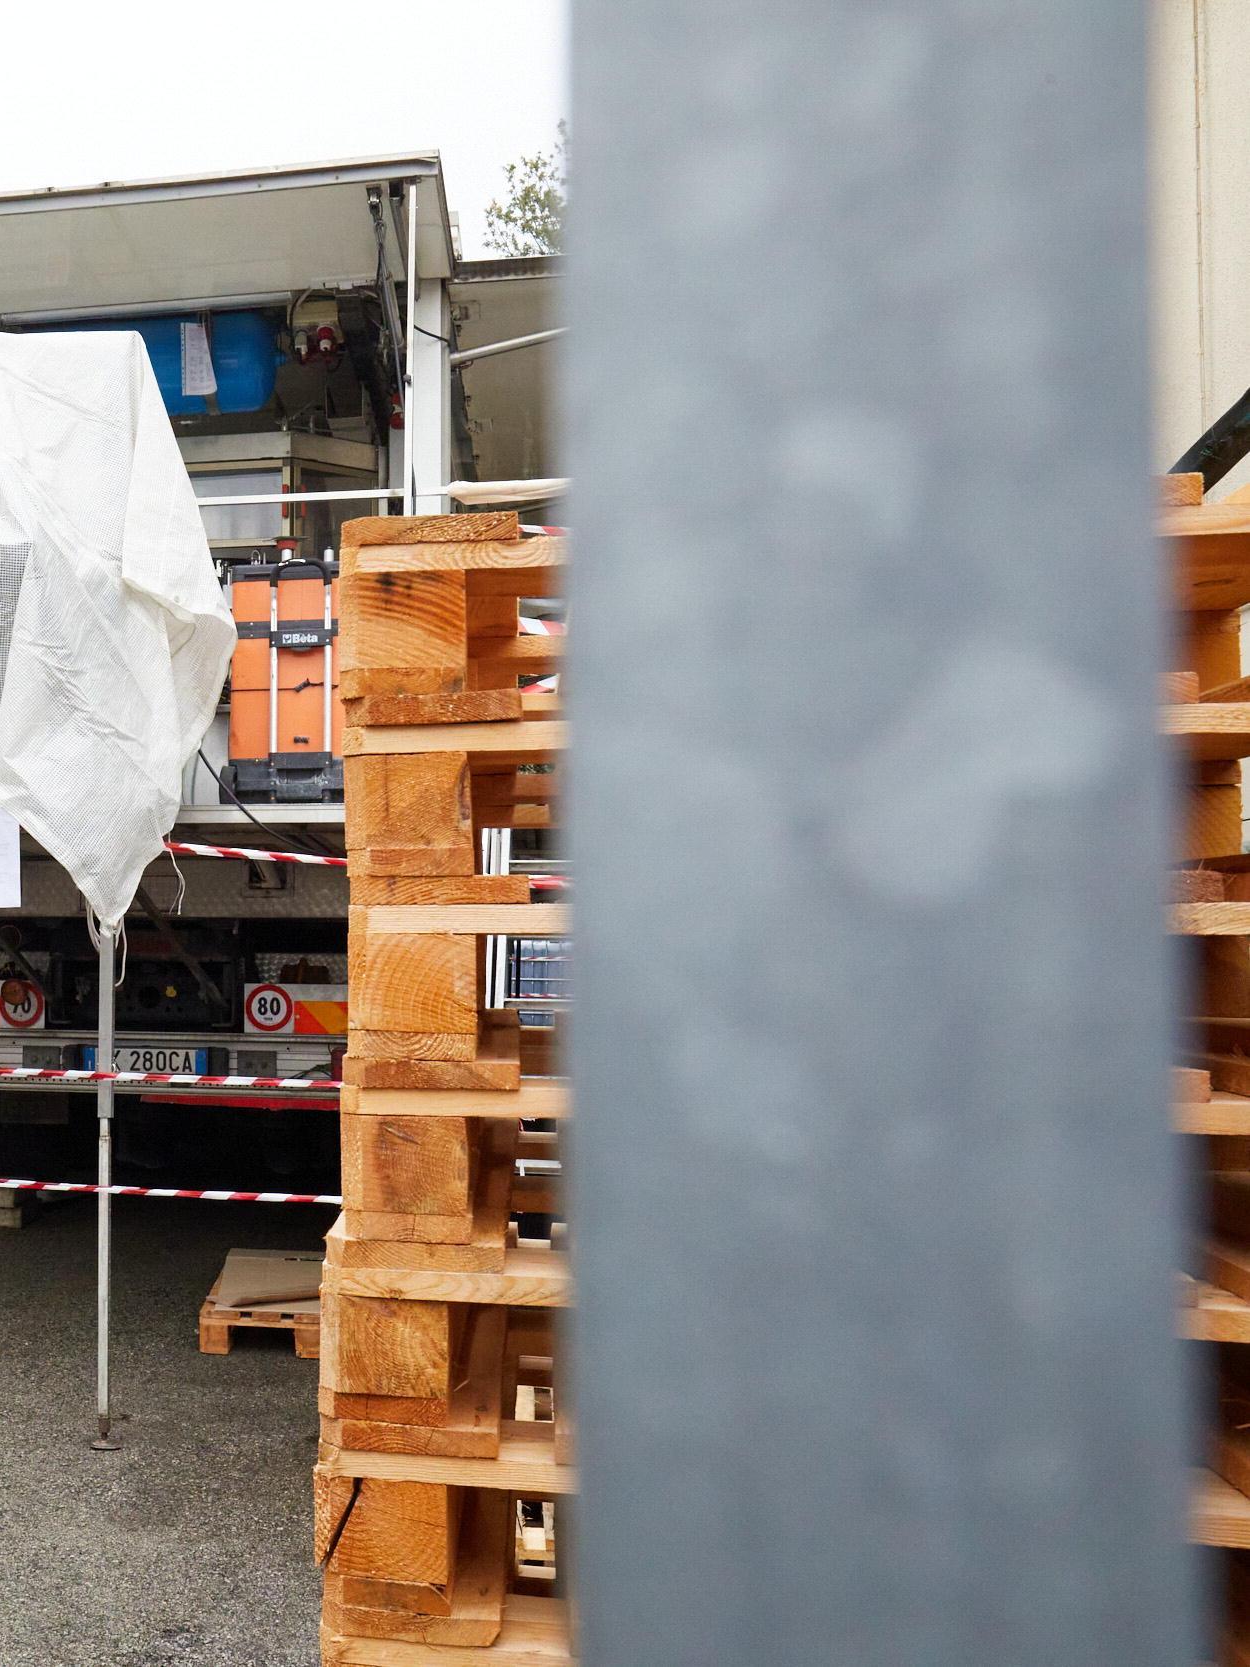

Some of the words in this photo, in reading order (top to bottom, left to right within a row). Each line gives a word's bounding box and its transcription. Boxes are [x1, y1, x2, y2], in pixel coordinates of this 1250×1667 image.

[292, 633, 319, 644] Beta
[257, 996, 281, 1016] 80
[130, 1050, 193, 1073] 280CA
